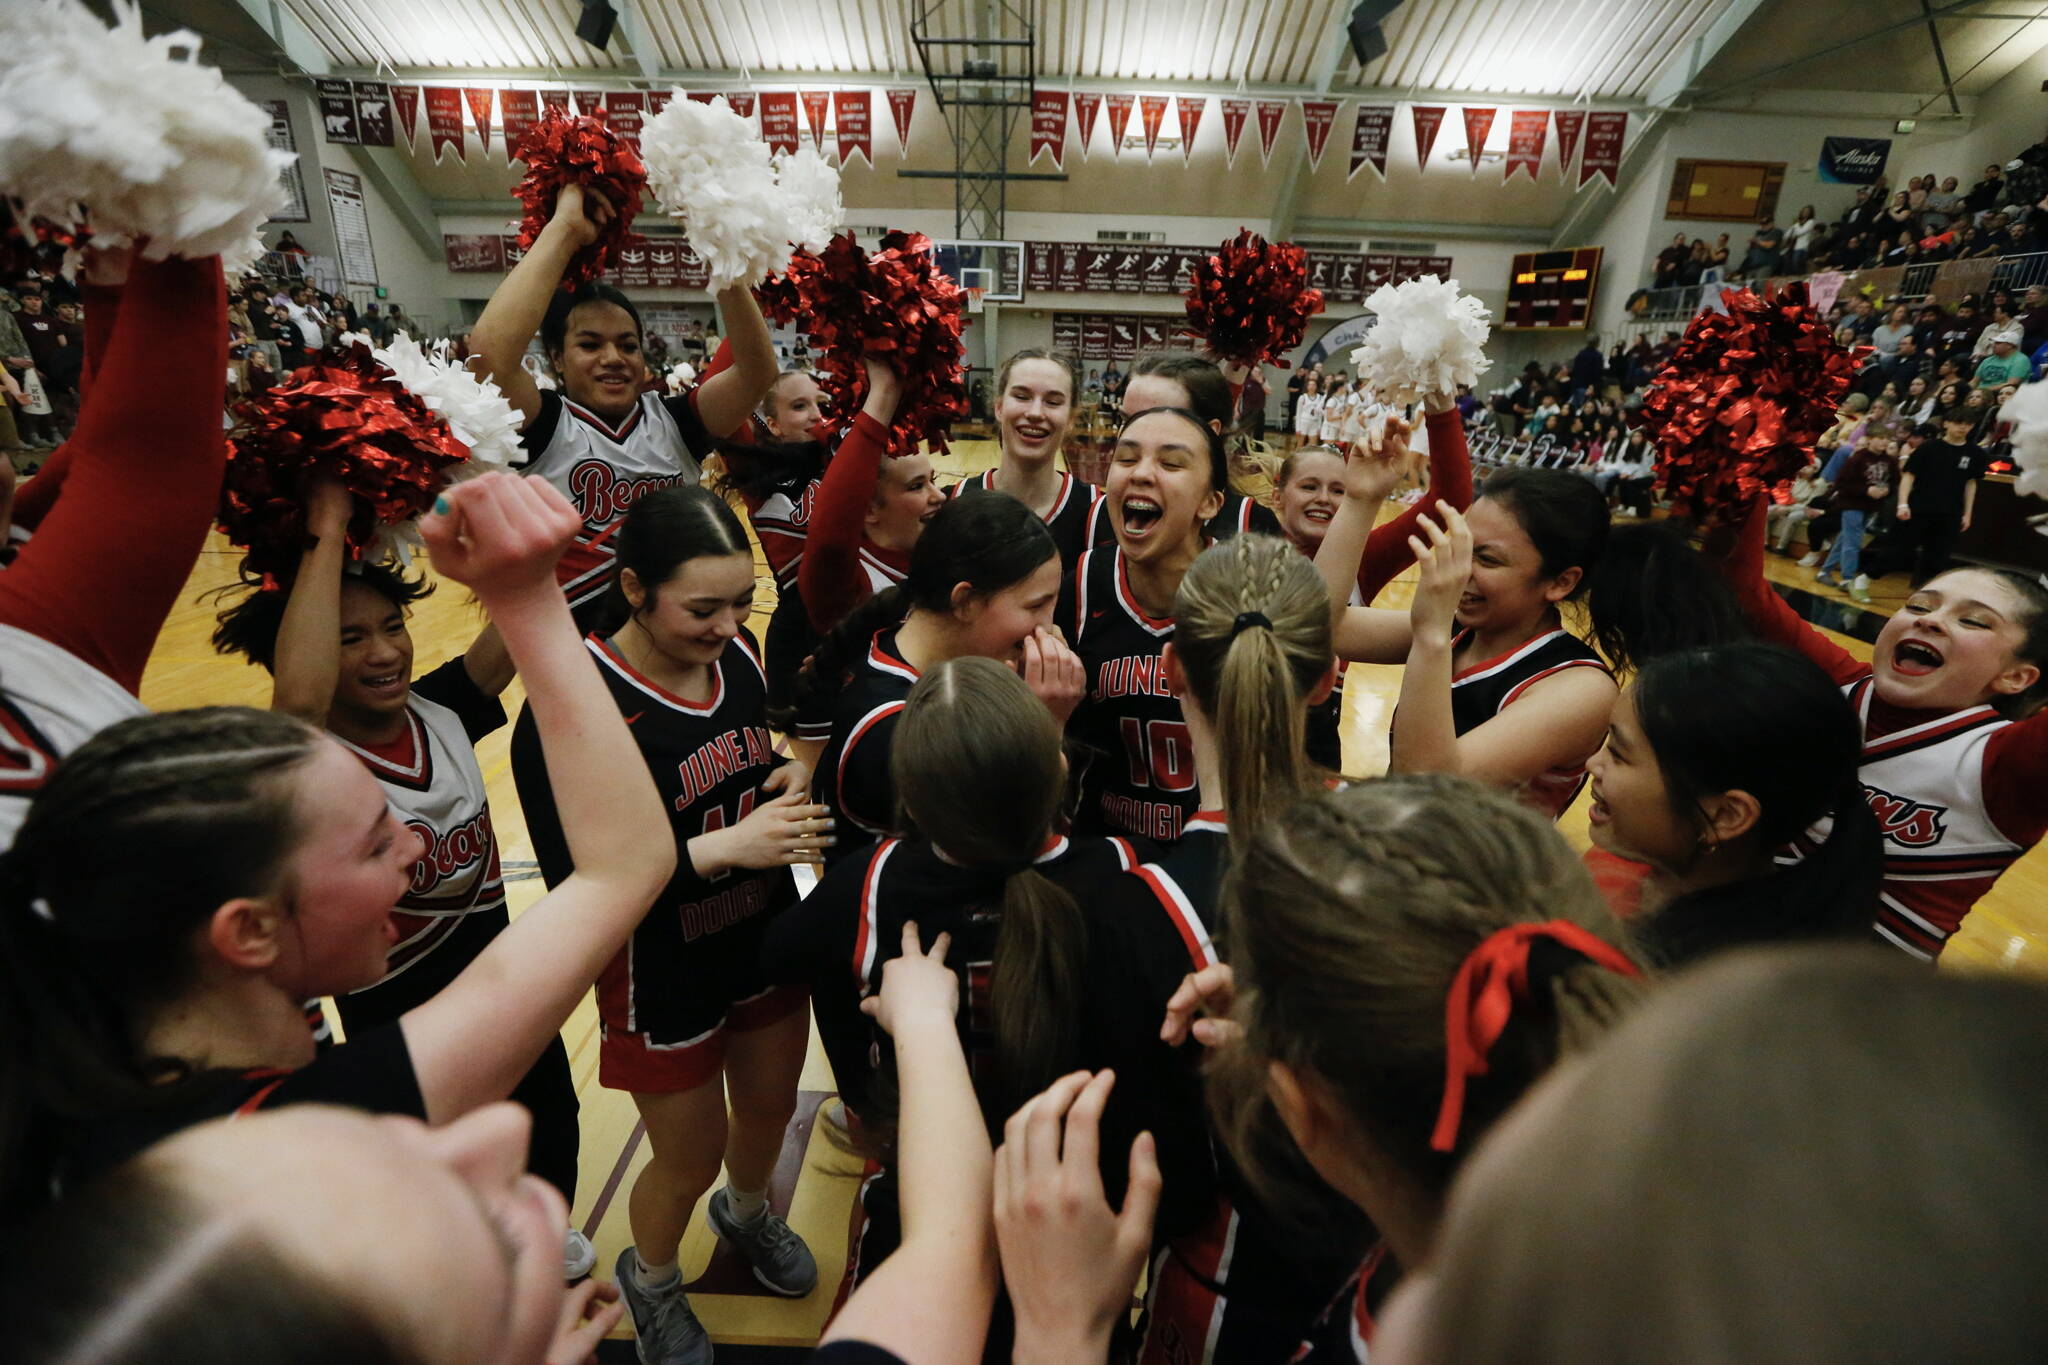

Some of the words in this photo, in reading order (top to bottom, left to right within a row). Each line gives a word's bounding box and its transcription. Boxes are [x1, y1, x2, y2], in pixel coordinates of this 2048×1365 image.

[1834, 148, 1881, 166] Alaska
[1091, 655, 1180, 703] JUNE
[1119, 716, 1196, 792] 10
